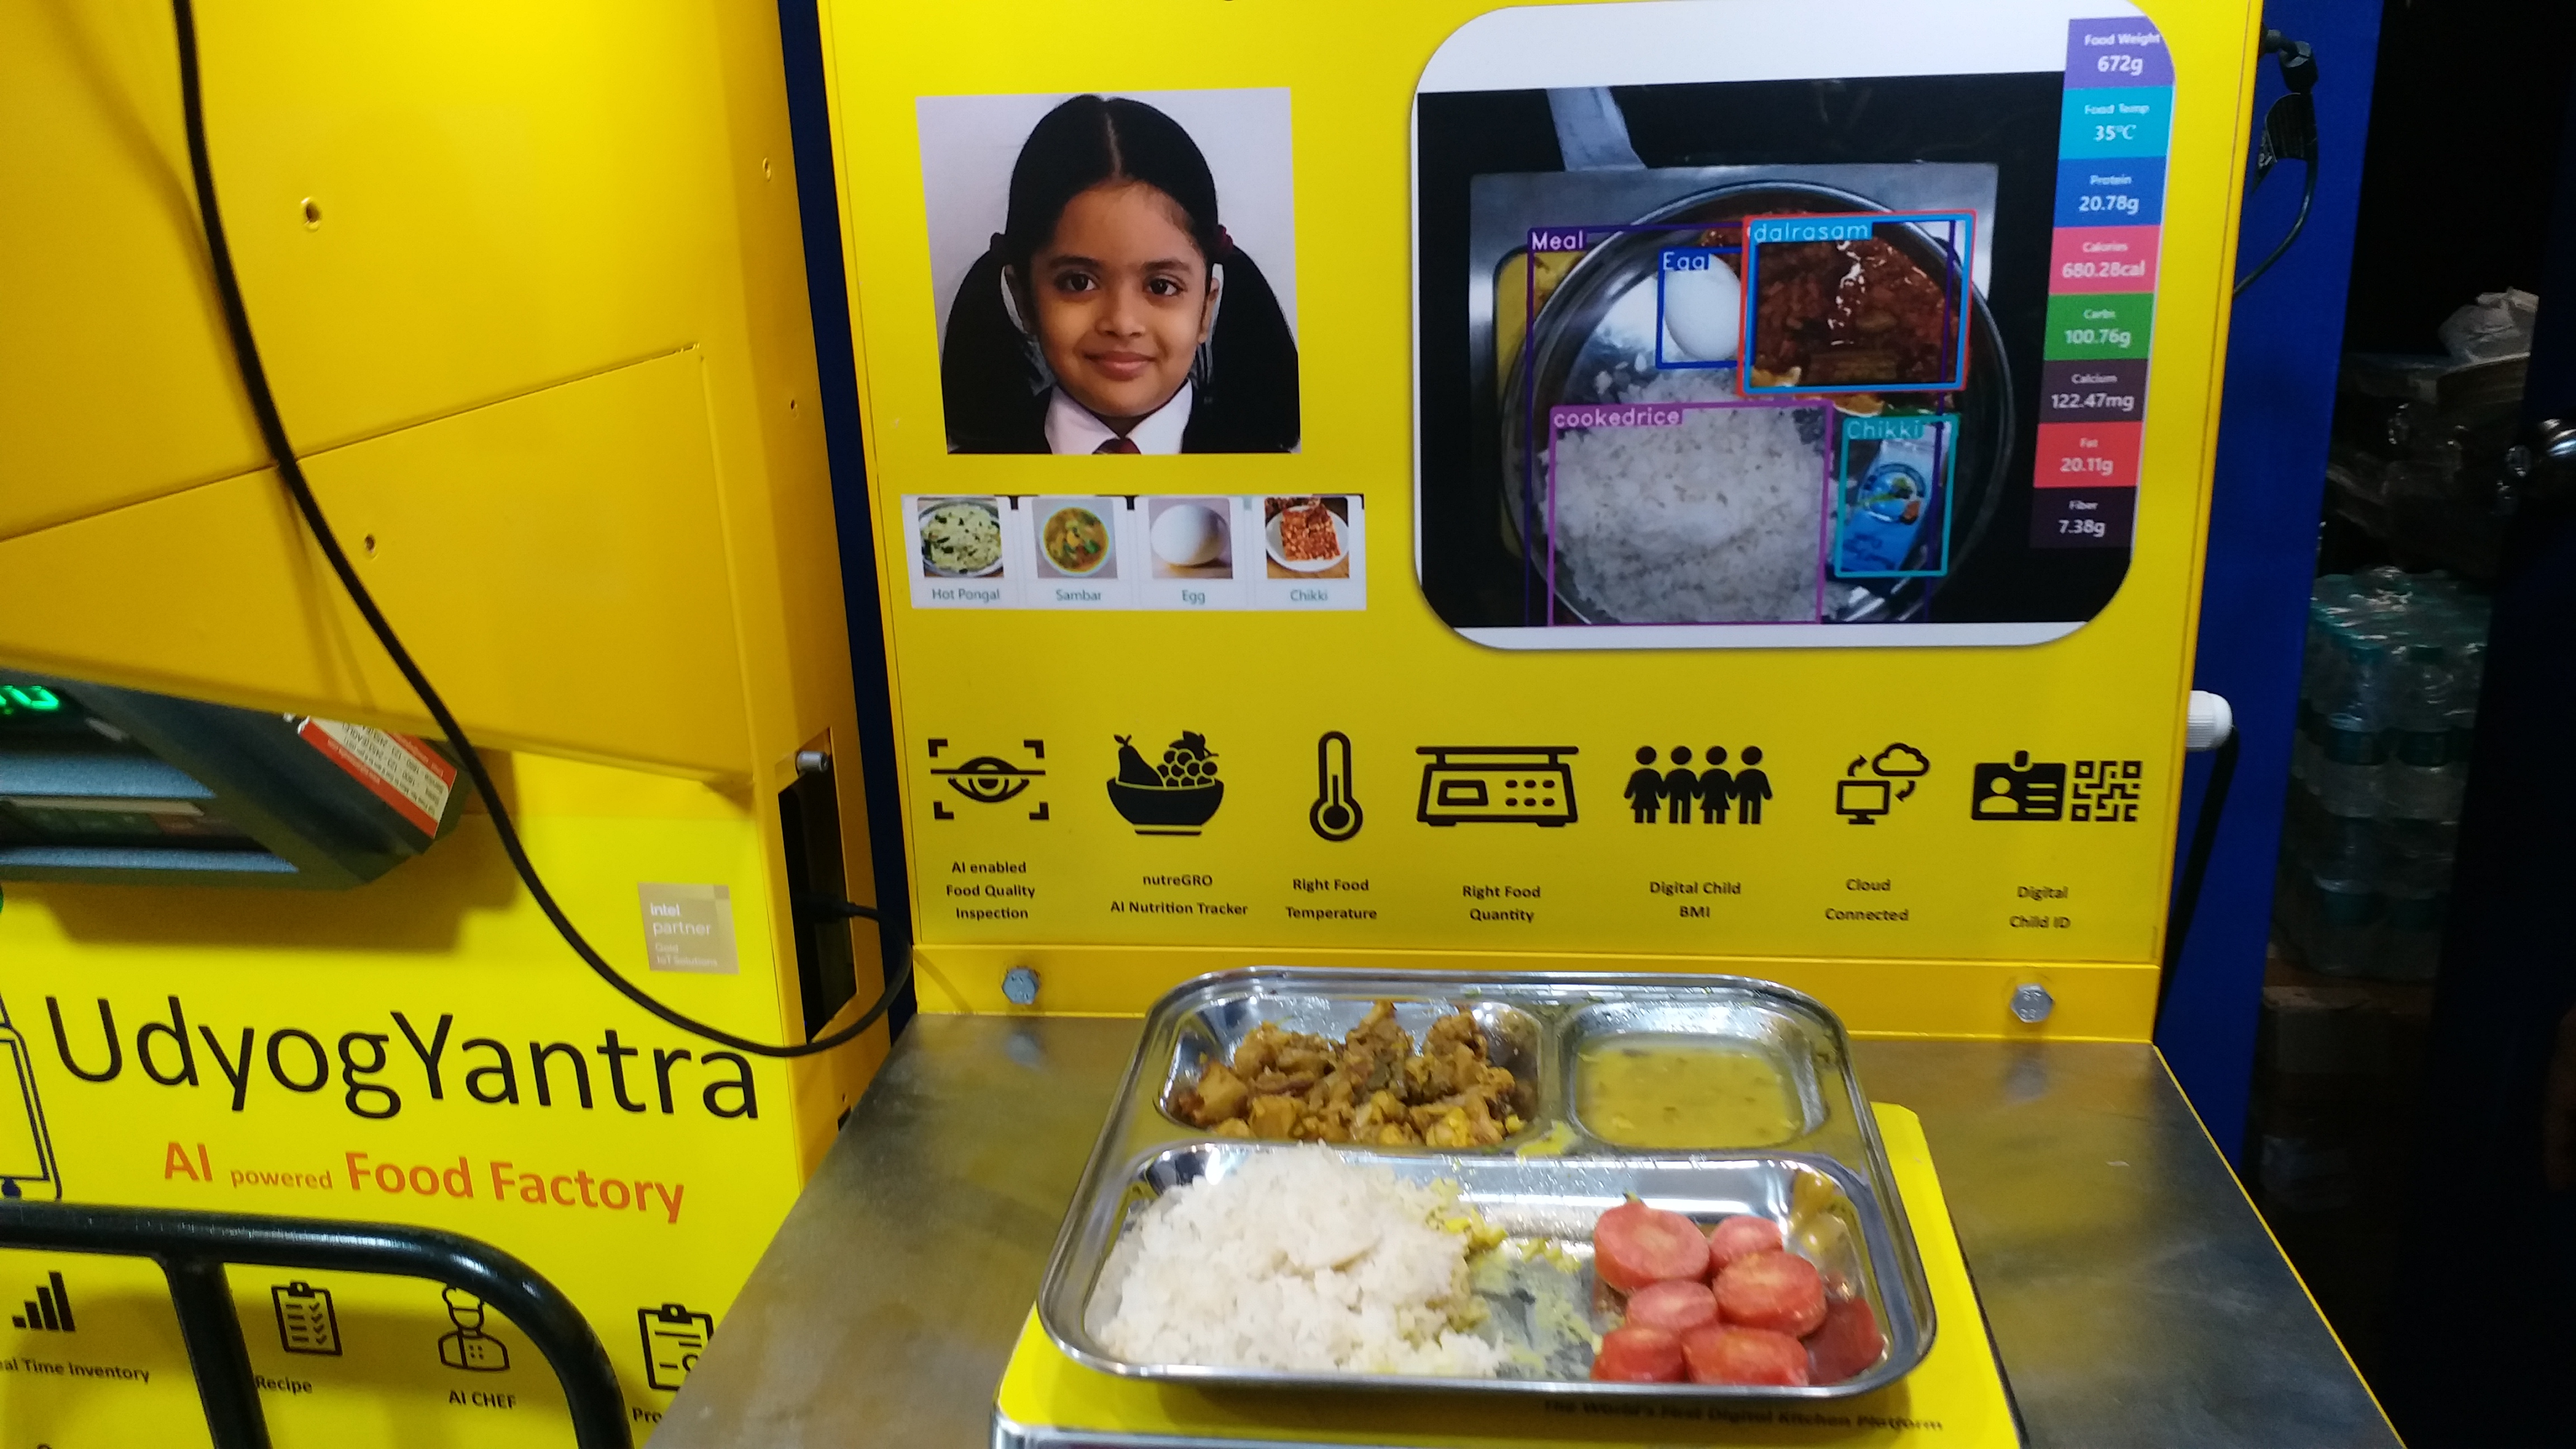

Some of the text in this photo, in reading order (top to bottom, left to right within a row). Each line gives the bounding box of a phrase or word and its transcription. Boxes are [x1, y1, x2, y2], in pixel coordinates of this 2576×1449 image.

[2085, 32, 2160, 47] Food Weight
[2097, 55, 2143, 76] 672g
[2085, 103, 2149, 115] Food Temp
[2090, 174, 2132, 186] Protein
[2078, 195, 2139, 215] 20.78g
[1754, 222, 1868, 242] dalrasam
[1532, 231, 1584, 250] Meal
[2083, 242, 2128, 252] Calories
[1663, 253, 1706, 272] Egg
[2062, 260, 2145, 278] 680.28cal
[2064, 329, 2131, 347] 100.76g
[2072, 374, 2117, 383] Calcium
[2052, 393, 2134, 411] 122.47mg
[1554, 406, 1679, 427] cookedrice
[1848, 420, 1919, 438] Chikki
[2080, 438, 2098, 448] Fat
[2059, 457, 2113, 476] 20.11g
[2069, 500, 2097, 510] Fiber
[2058, 520, 2106, 537] 7.38g
[932, 588, 1000, 604] Hot Pongal
[1056, 590, 1101, 601] Sambar
[1182, 590, 1205, 604] Egg
[1290, 589, 1328, 601] Chikki
[952, 861, 1026, 874] AI enabled
[1143, 874, 1213, 887] nutreGRO
[1292, 879, 1368, 893] Right Food
[1650, 880, 1741, 896] Digital Child
[1846, 877, 1891, 892] Cloud
[946, 886, 1035, 899] Food Quality
[1463, 884, 1540, 900] Right Food
[2018, 884, 2068, 902] Digital
[956, 908, 1028, 921] Inspection
[1111, 902, 1247, 916] AI Nutrition Tracker
[1286, 907, 1377, 922] Temperature
[1470, 908, 1534, 923] Quantity
[1679, 906, 1710, 919] BMI
[1826, 907, 1909, 921] Connected
[653, 921, 711, 937] partner
[2010, 916, 2071, 929] Child ID
[45, 995, 759, 1120] UdyogYantra
[164, 1141, 685, 1224] AI powered Food Factory
[21, 1357, 65, 1375] Time
[68, 1361, 149, 1385] Inventory
[255, 1375, 312, 1396] Recipe
[448, 1389, 517, 1411] AI CHEF
[1857, 1415, 1943, 1432] Platform
